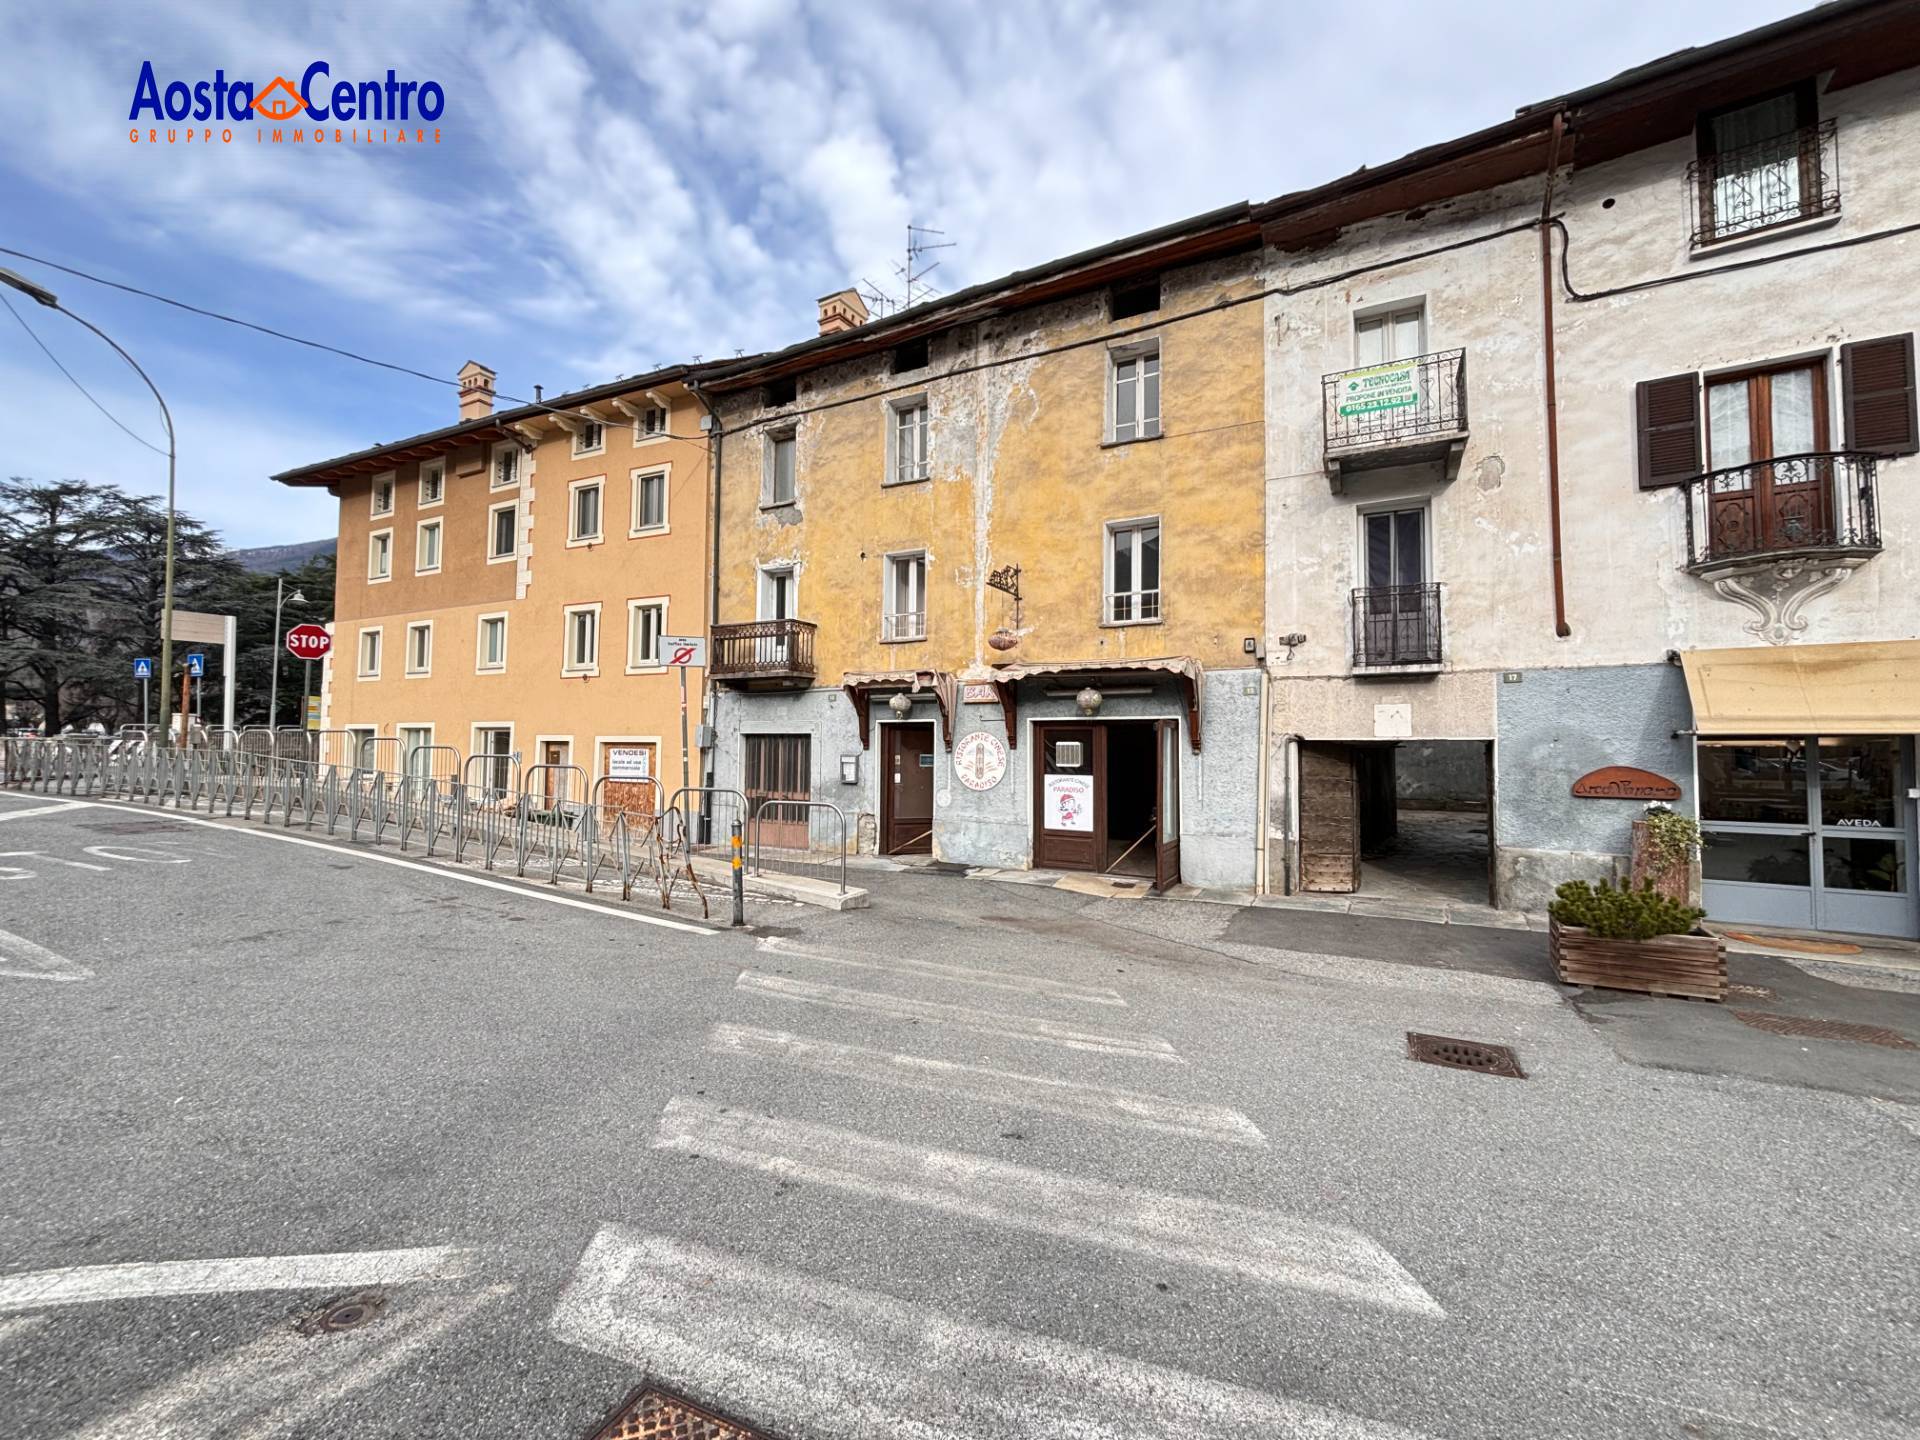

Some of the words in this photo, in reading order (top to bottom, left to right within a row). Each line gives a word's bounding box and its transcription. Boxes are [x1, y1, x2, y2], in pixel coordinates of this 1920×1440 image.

[1362, 371, 1410, 388] TECNOCASA
[1345, 391, 1377, 402] PROPONE
[1377, 389, 1385, 397] IN
[1385, 385, 1412, 396] VENDITA
[1345, 403, 1365, 412] 0165
[290, 634, 329, 649] STOP
[1509, 673, 1518, 681] 17
[955, 733, 990, 766] RISTORANTE
[990, 738, 1005, 767] CINESE
[961, 775, 998, 789] PARADISO
[1837, 818, 1881, 827] AVEDA
